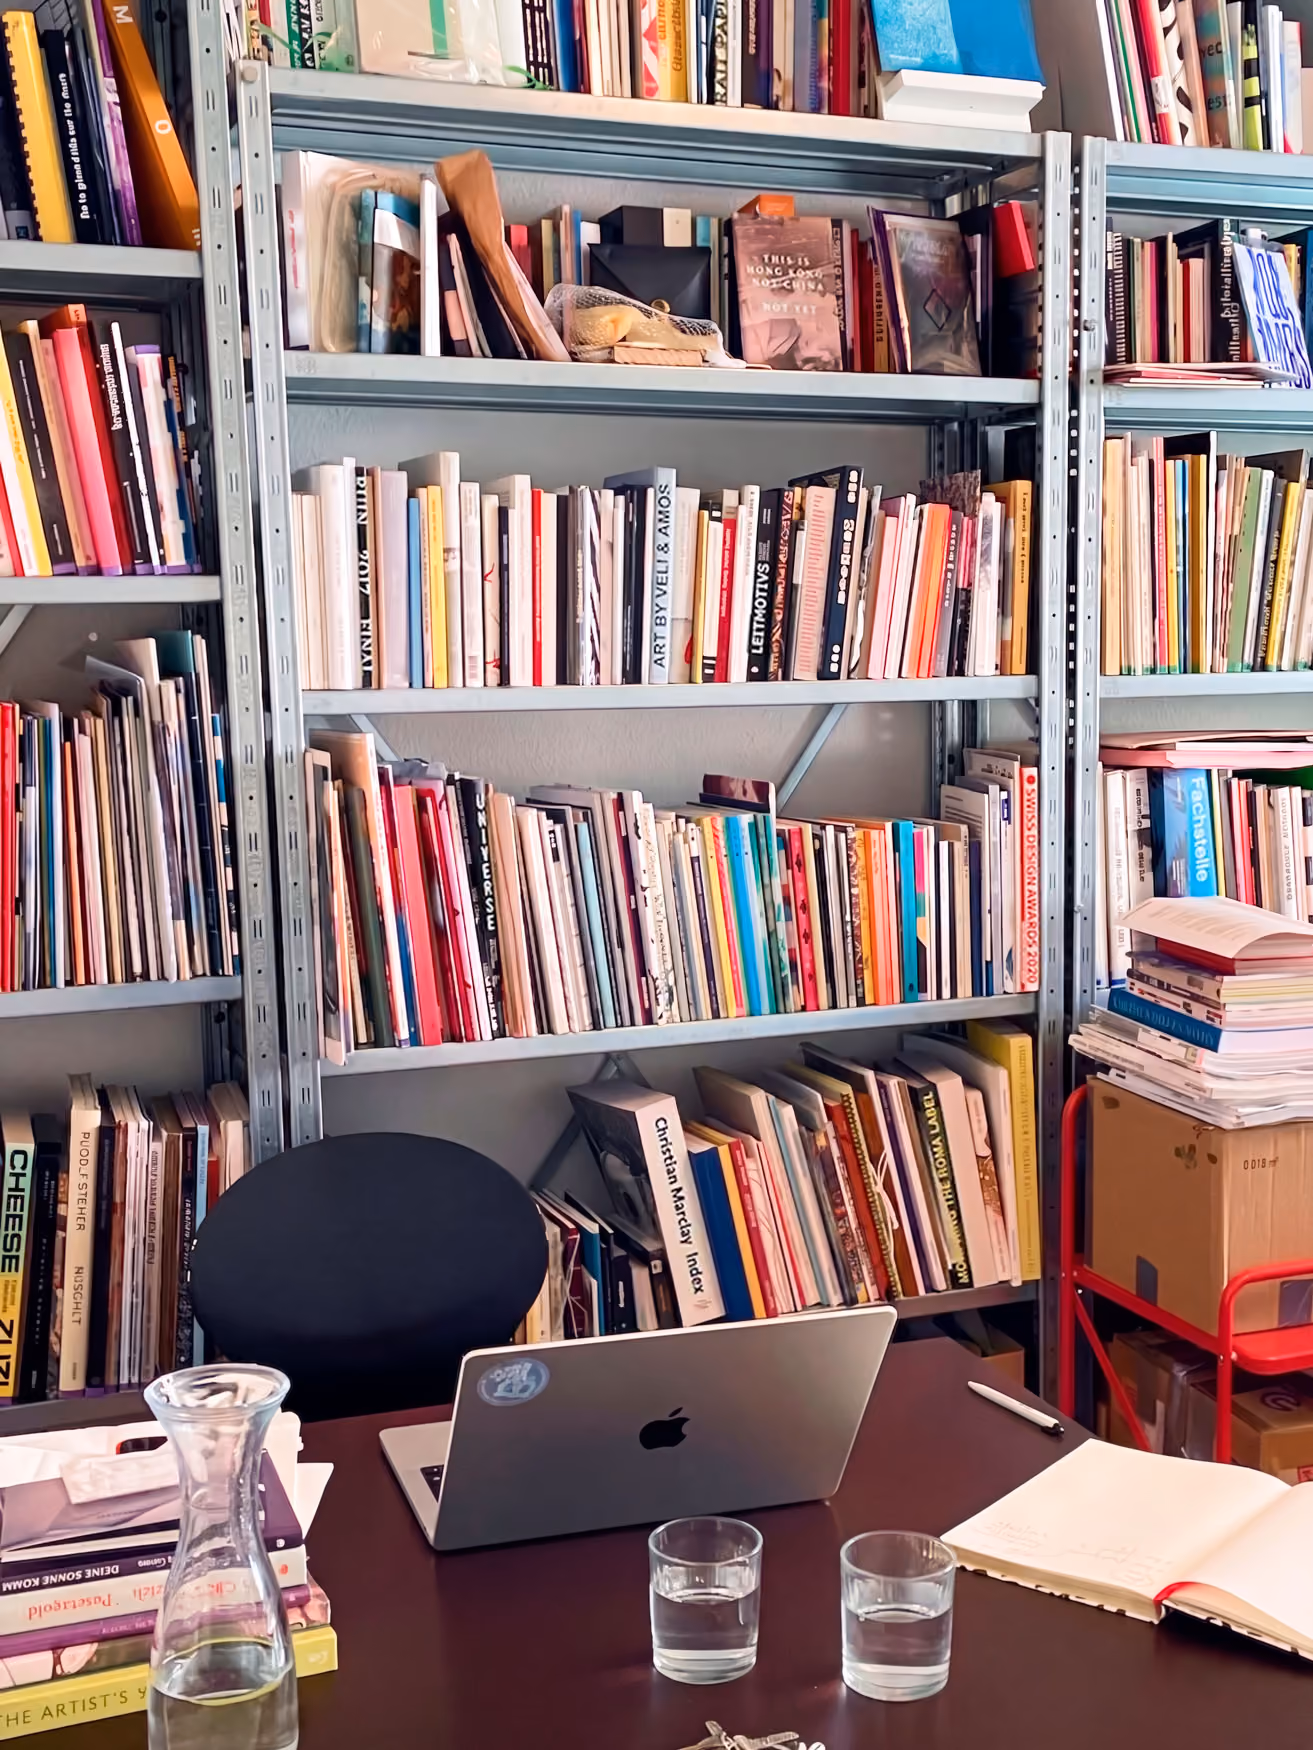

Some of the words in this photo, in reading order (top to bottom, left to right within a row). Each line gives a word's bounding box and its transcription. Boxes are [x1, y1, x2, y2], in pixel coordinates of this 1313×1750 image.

[746, 265, 782, 276] HONG
[763, 254, 793, 265] THIS
[797, 257, 810, 267] IS
[783, 280, 824, 291] CHINA
[762, 302, 788, 313] NOT
[794, 305, 817, 315] YET
[657, 483, 672, 537] AMOS
[656, 543, 670, 554] &
[656, 559, 669, 597] VELI
[655, 604, 668, 627] BY
[751, 563, 770, 655] LEITMOTIVS
[653, 635, 666, 669] ART
[1025, 788, 1037, 831] SWISS
[1191, 776, 1210, 882] Fachstelle
[1025, 834, 1037, 886] DESIGN
[1026, 888, 1038, 948] AWARDS
[1027, 951, 1038, 984] 2020
[923, 1091, 940, 1135] LABEL
[930, 1137, 948, 1177] ROMA
[654, 1116, 678, 1186] Christian
[670, 1187, 694, 1246] Marclay
[686, 1252, 705, 1295] Index
[941, 1179, 956, 1209] THE
[0, 1149, 28, 1274] CHEESE
[2, 1576, 40, 1592] KOMM
[42, 1570, 83, 1586] SONNE
[85, 1564, 120, 1579] DEINE
[41, 1690, 128, 1720] ARTIST'S
